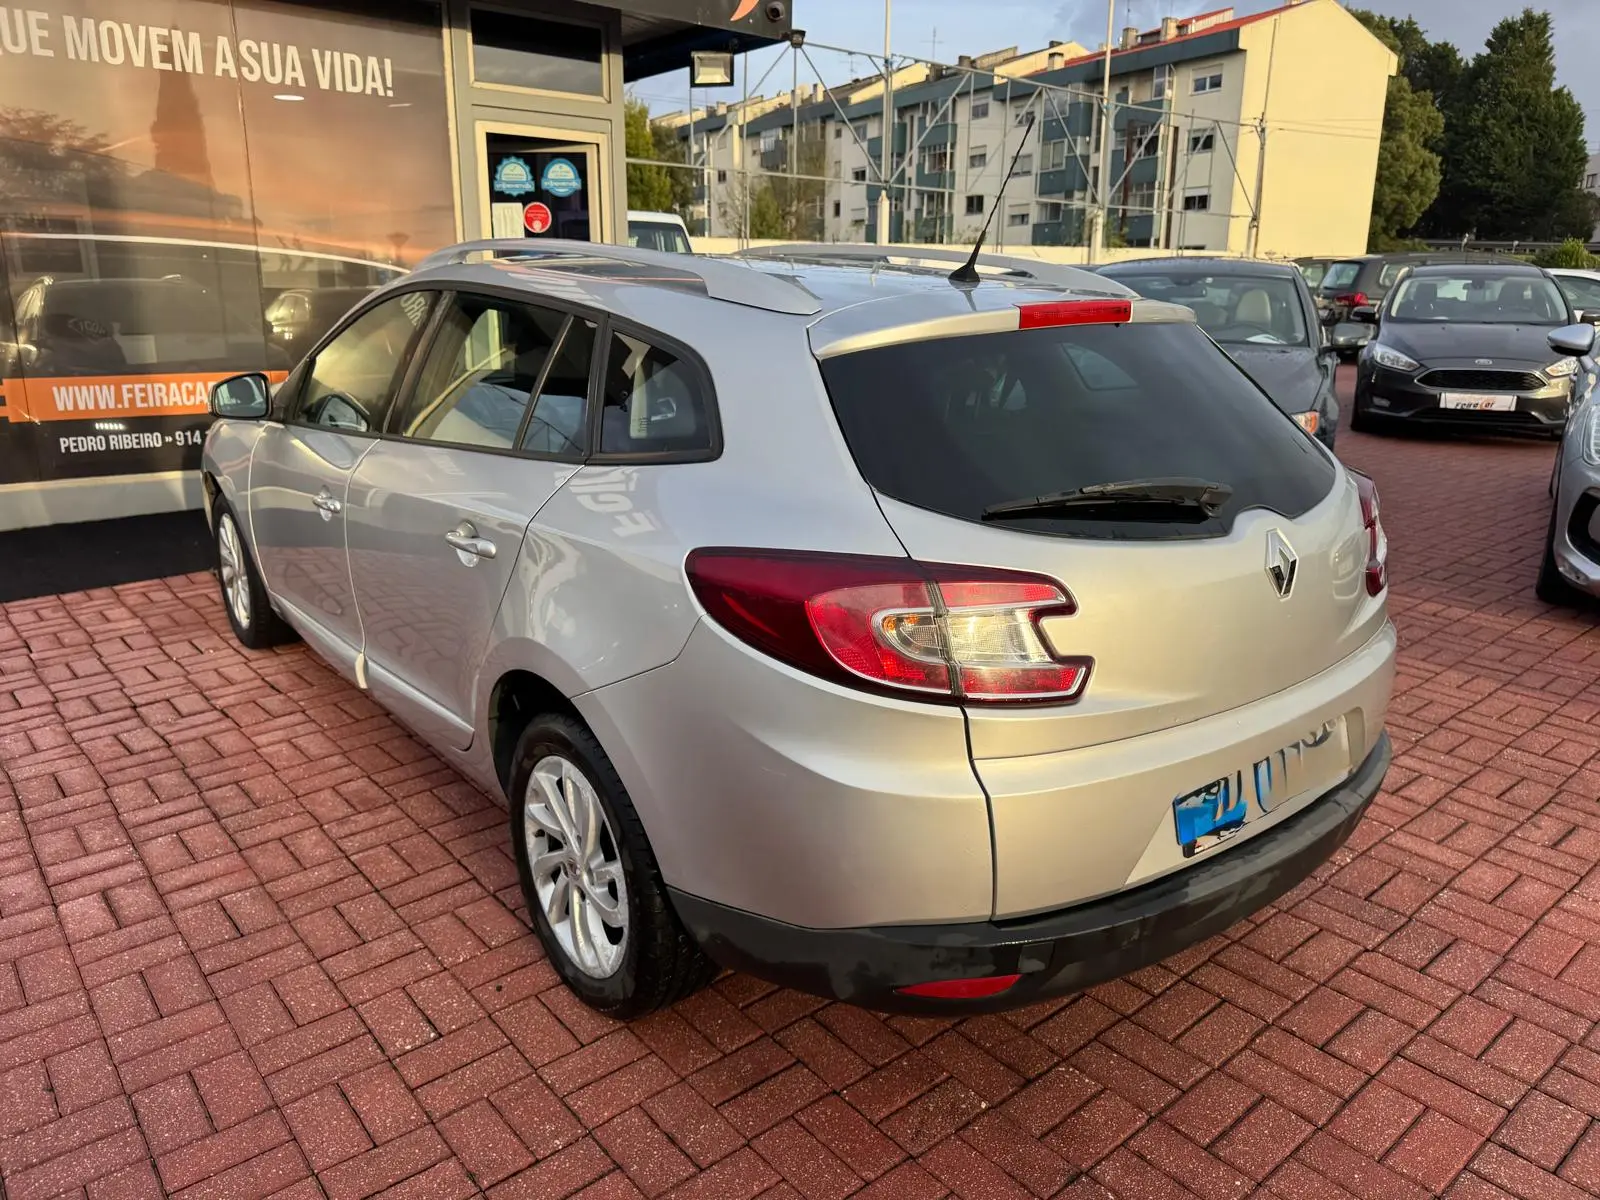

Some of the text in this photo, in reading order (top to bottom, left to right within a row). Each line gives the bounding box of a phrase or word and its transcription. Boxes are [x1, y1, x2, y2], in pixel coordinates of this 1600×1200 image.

[0, 6, 54, 58] UE
[62, 16, 204, 75] MOVEM
[311, 48, 394, 97] VIDA!
[59, 434, 106, 453] PEDRO
[109, 431, 162, 450] RIBEIRO
[175, 430, 202, 446] 914
